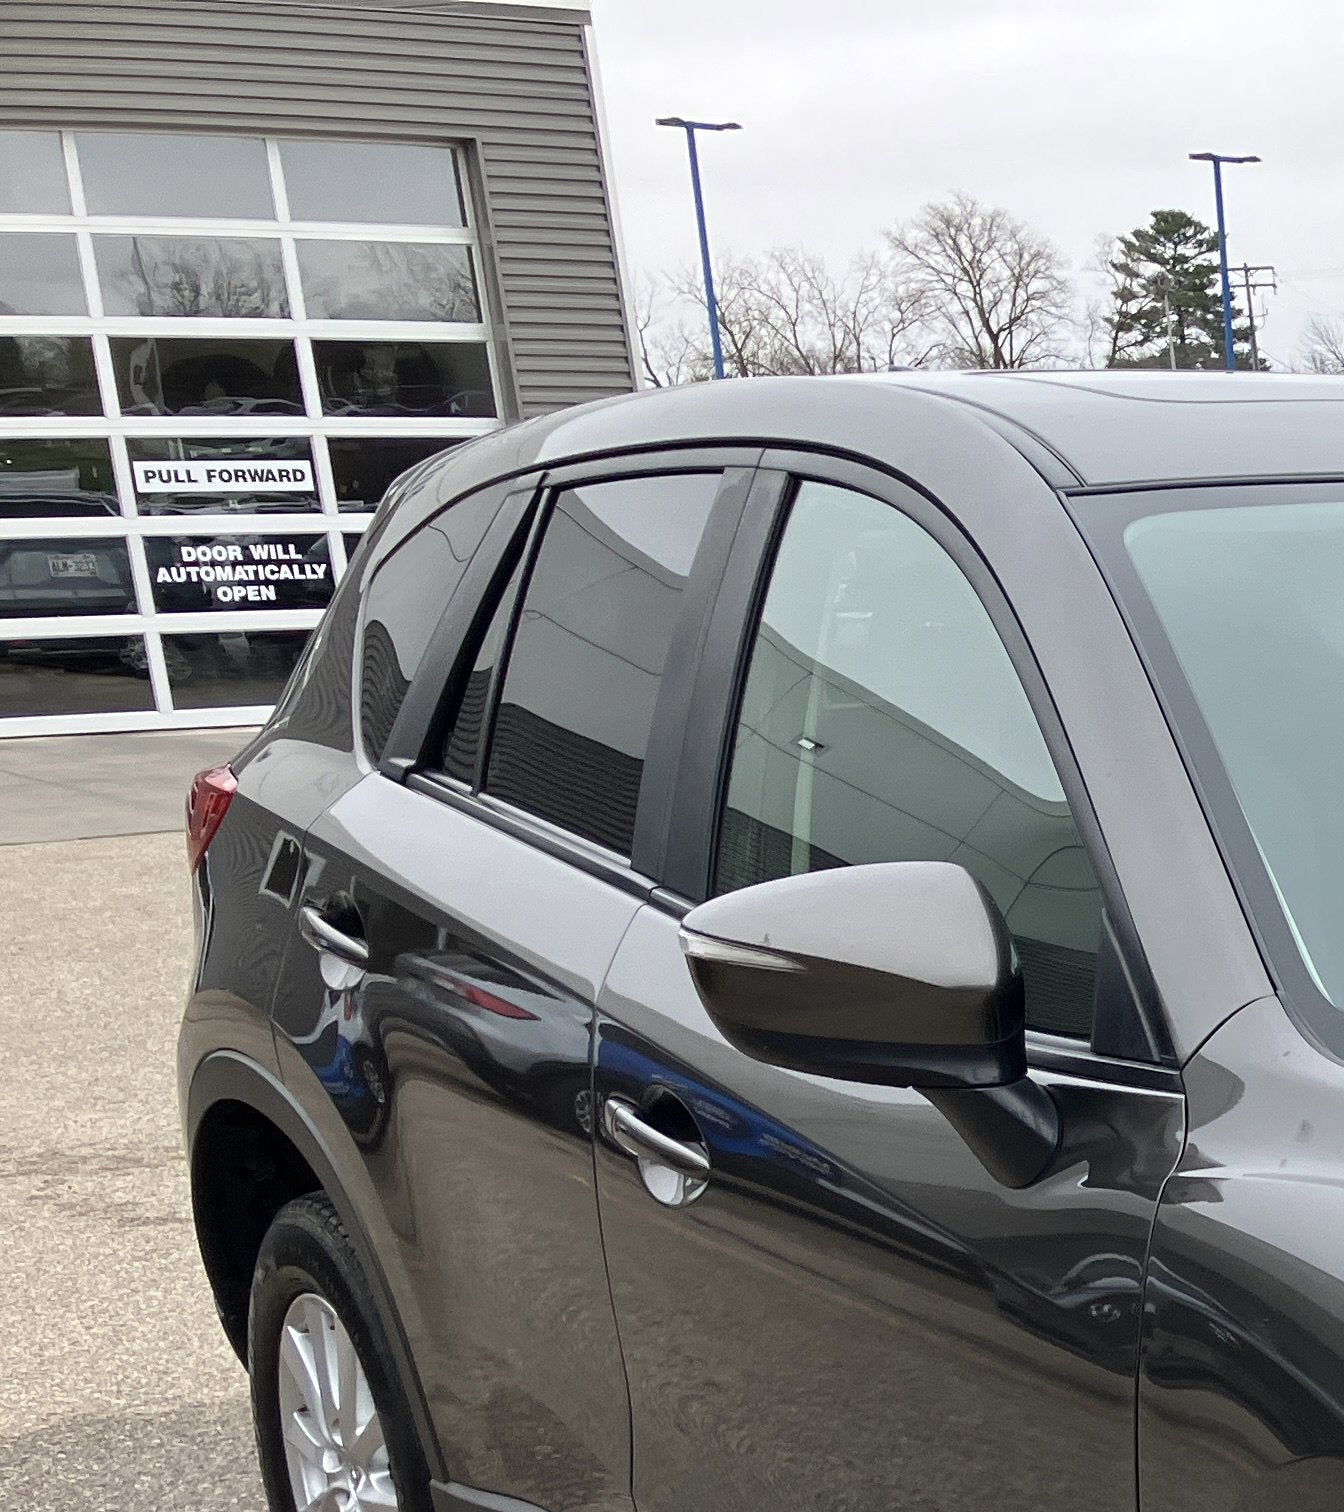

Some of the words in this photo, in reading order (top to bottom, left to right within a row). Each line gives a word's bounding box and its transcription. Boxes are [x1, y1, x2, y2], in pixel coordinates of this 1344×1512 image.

[143, 469, 198, 484] PULL
[205, 468, 306, 483] FORWARD
[180, 545, 244, 562] DOOR
[249, 543, 303, 560] WILL
[156, 563, 327, 583] AUTOMATICALLY
[216, 584, 277, 602] OPEN
